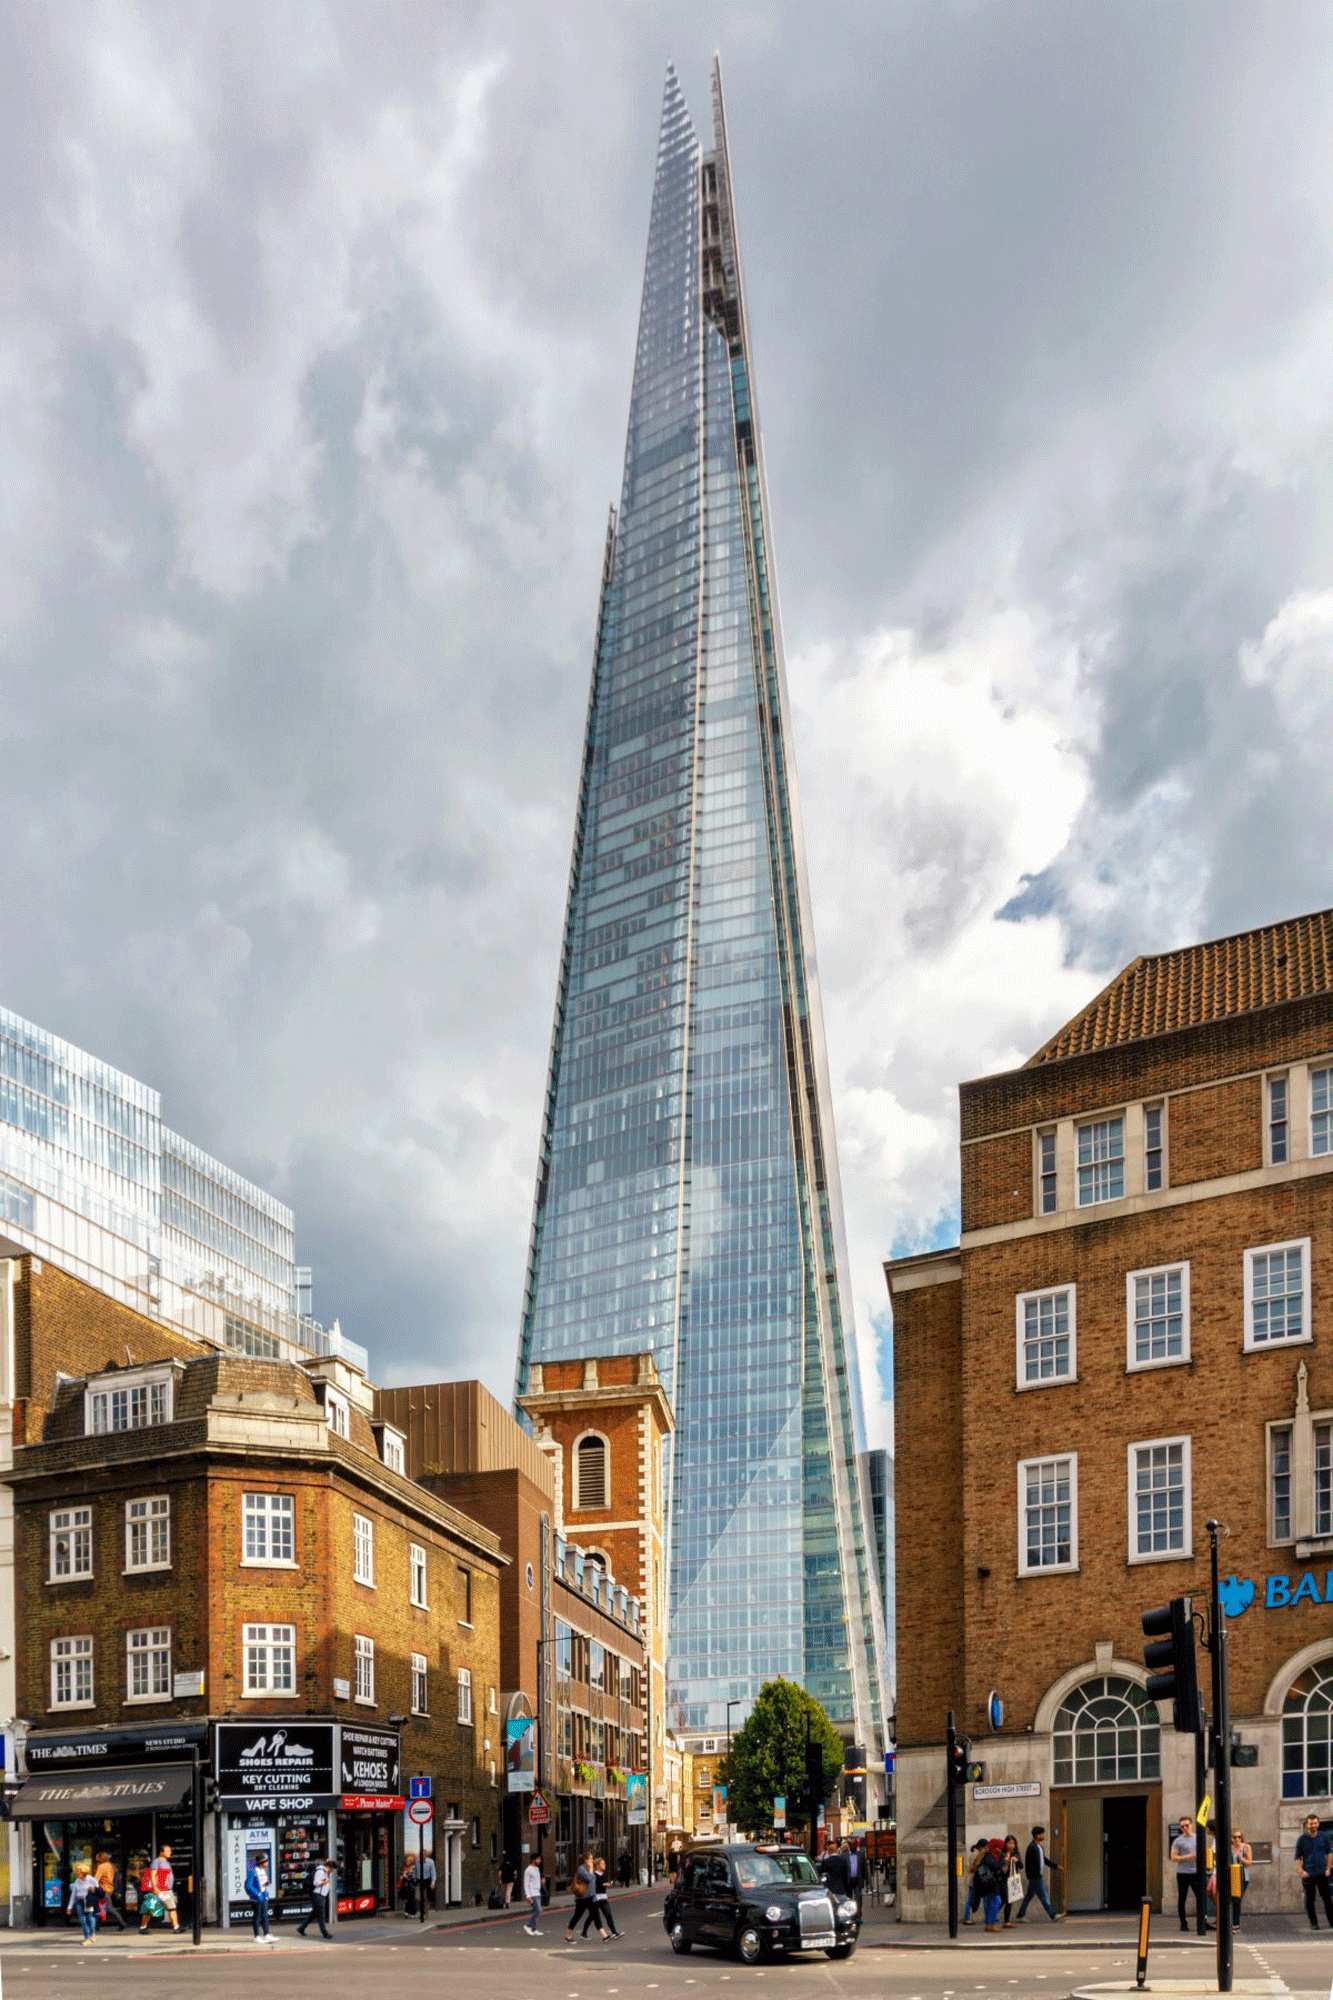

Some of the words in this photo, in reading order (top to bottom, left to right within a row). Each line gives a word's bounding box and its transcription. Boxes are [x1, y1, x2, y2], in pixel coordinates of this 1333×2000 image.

[30, 1748, 52, 1759] THE
[76, 1743, 108, 1756] TIMES
[239, 1758, 273, 1767] SHOES
[275, 1758, 314, 1766] REPAIR
[353, 1760, 388, 1780] KEHOE'S
[242, 1774, 263, 1785] KEY
[264, 1773, 311, 1784] CUTTING
[39, 1788, 75, 1801] THE
[113, 1781, 166, 1796] TIMES
[254, 1784, 267, 1792] DRY
[268, 1783, 299, 1791] CLEANING
[975, 1787, 1001, 1795] BOROUGH
[1015, 1784, 1032, 1792] STREET
[245, 1799, 277, 1811] VAPE
[279, 1798, 314, 1810] SHOP
[249, 1830, 269, 1838] ATM
[230, 1910, 243, 1918] KEY
